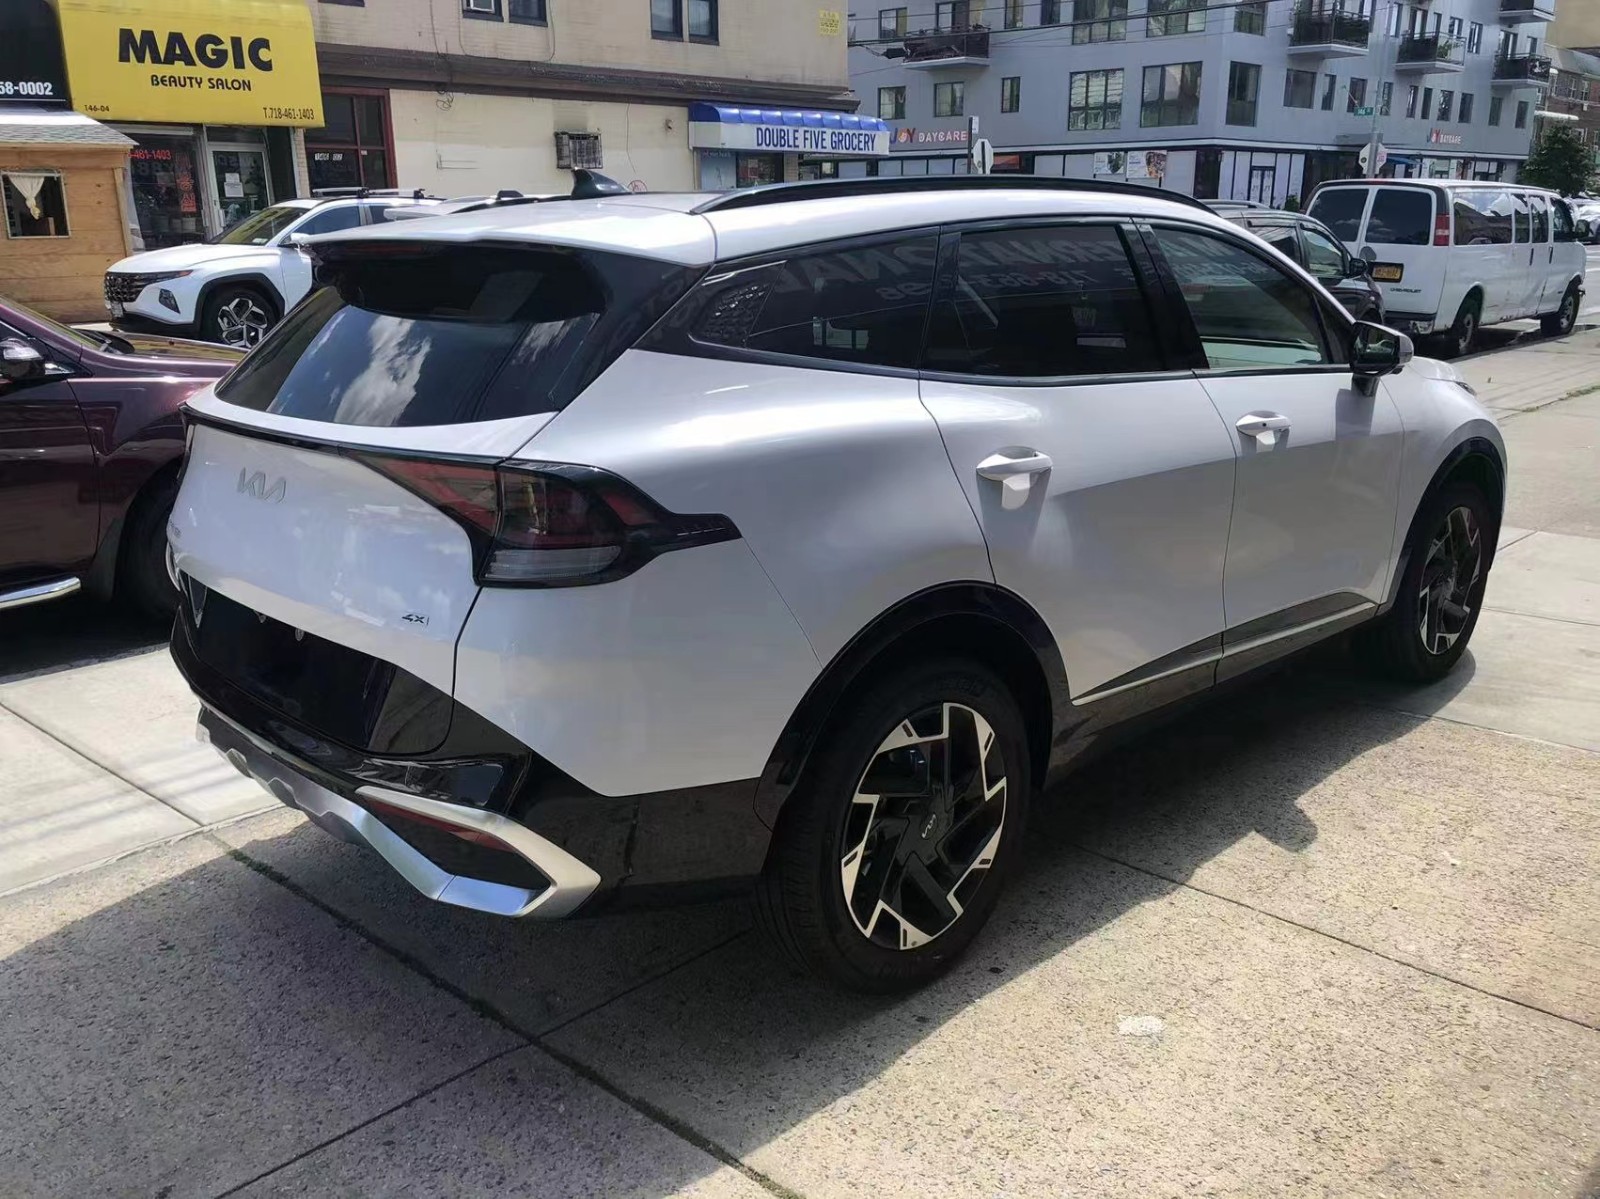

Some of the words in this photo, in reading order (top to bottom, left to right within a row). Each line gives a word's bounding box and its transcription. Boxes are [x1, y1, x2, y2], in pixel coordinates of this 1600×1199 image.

[118, 28, 273, 72] MAGIC
[0, 81, 53, 96] 58-0002
[150, 74, 203, 89] BEAUTY
[208, 78, 251, 92] SALON
[263, 107, 314, 120] T.718-461-1403
[756, 127, 799, 148] DOUBLE
[803, 129, 826, 149] FIVE
[830, 131, 876, 151] GROCERY
[918, 131, 968, 143] DAYCARE
